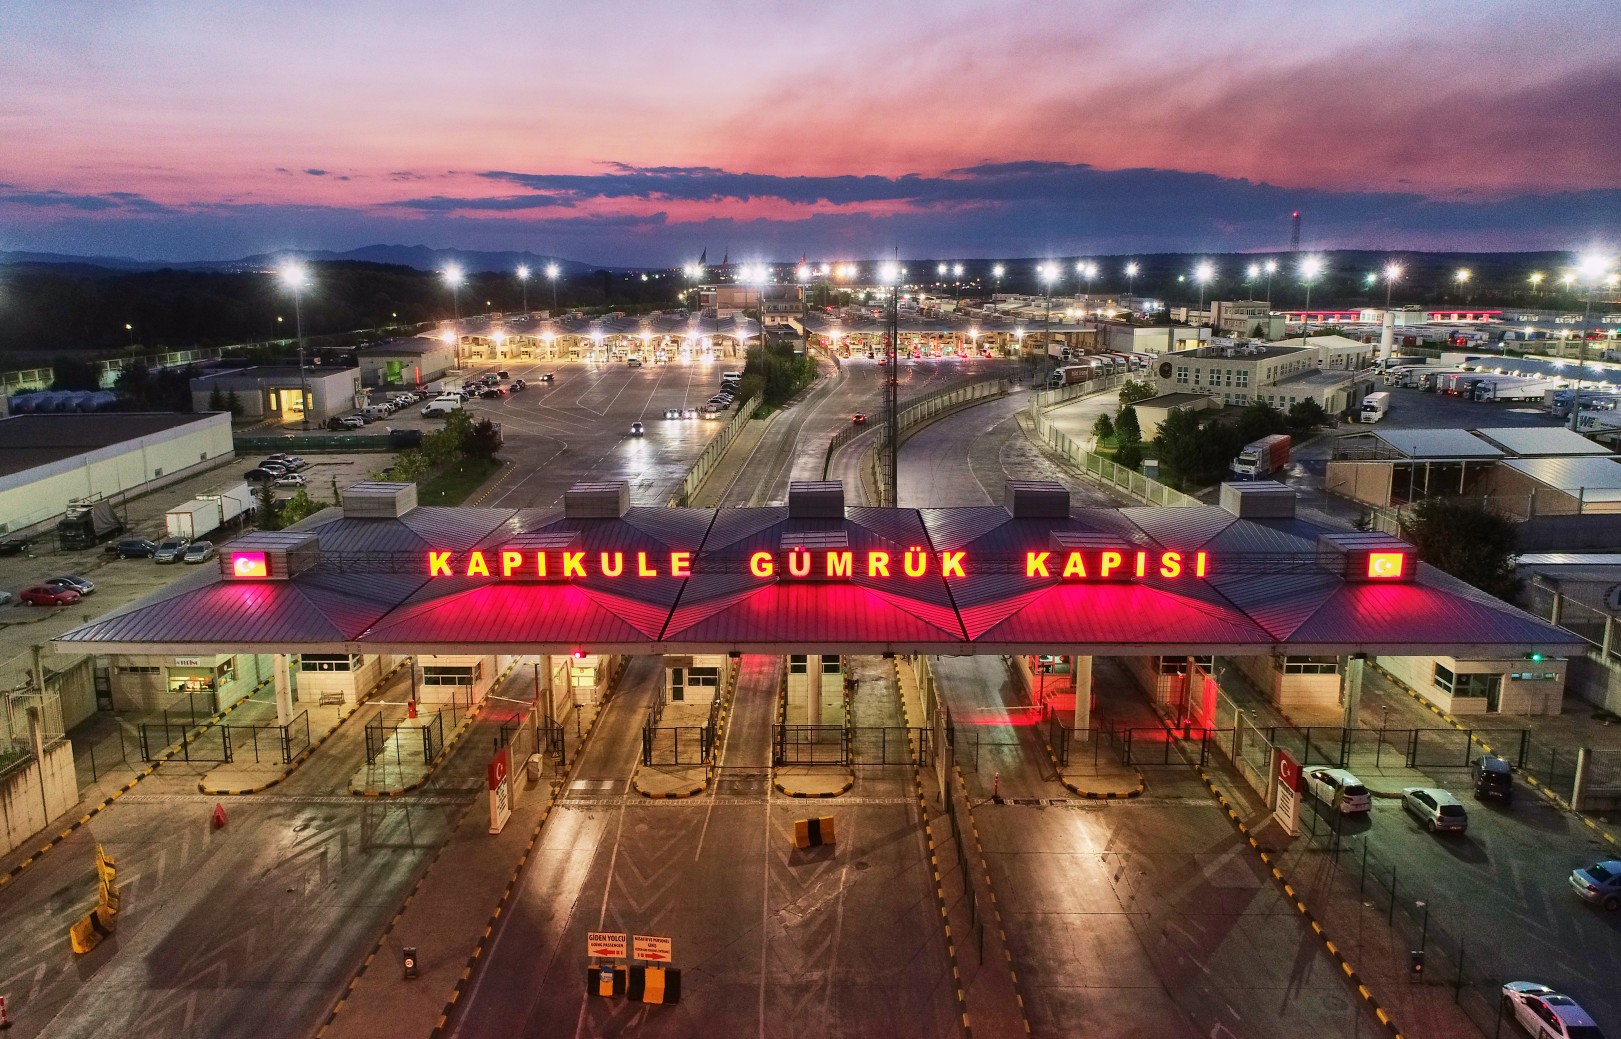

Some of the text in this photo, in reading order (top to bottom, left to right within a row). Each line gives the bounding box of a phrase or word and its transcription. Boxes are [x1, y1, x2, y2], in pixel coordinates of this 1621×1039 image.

[428, 546, 1207, 578] KAPIKULE GÜMRÜK KAPISI
